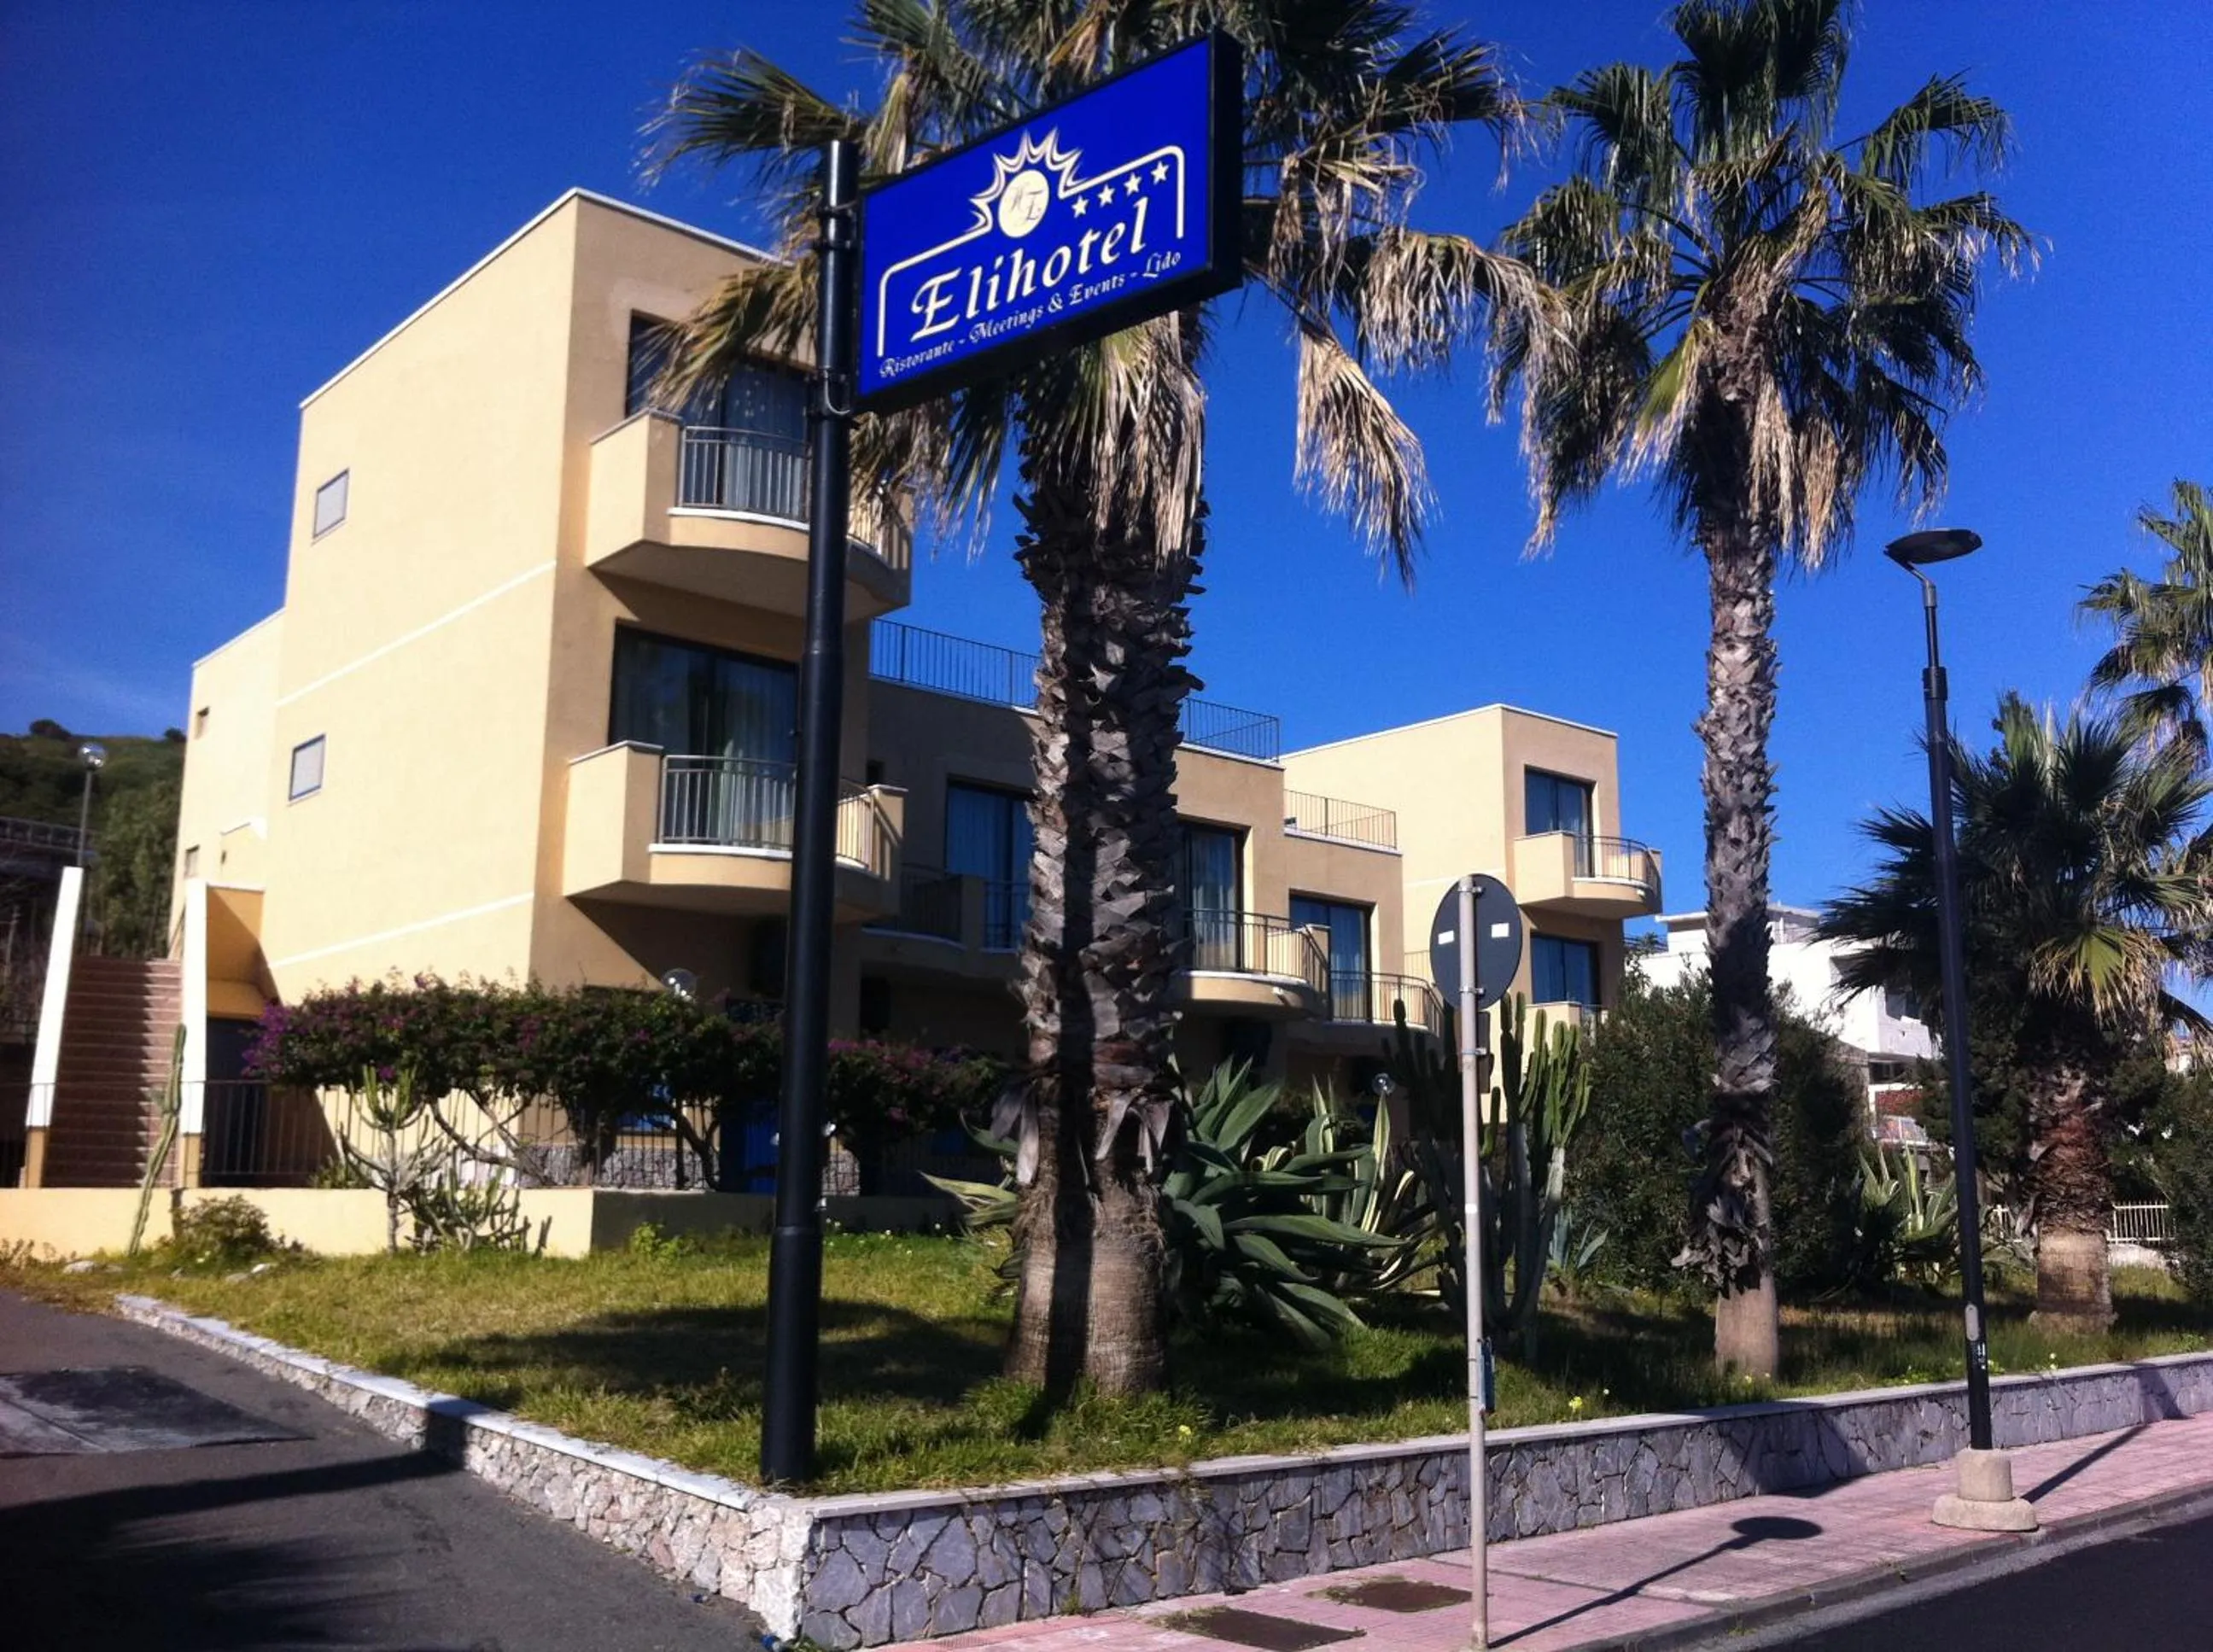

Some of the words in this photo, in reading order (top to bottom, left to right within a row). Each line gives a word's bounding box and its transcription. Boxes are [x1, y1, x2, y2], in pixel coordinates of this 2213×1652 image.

[879, 339, 955, 378] Ristorante
[969, 305, 1044, 343] Meetings
[1048, 293, 1064, 313] &
[1069, 273, 1126, 306] Events
[1142, 250, 1182, 278] Lido
[909, 196, 1149, 342] Elihotel
